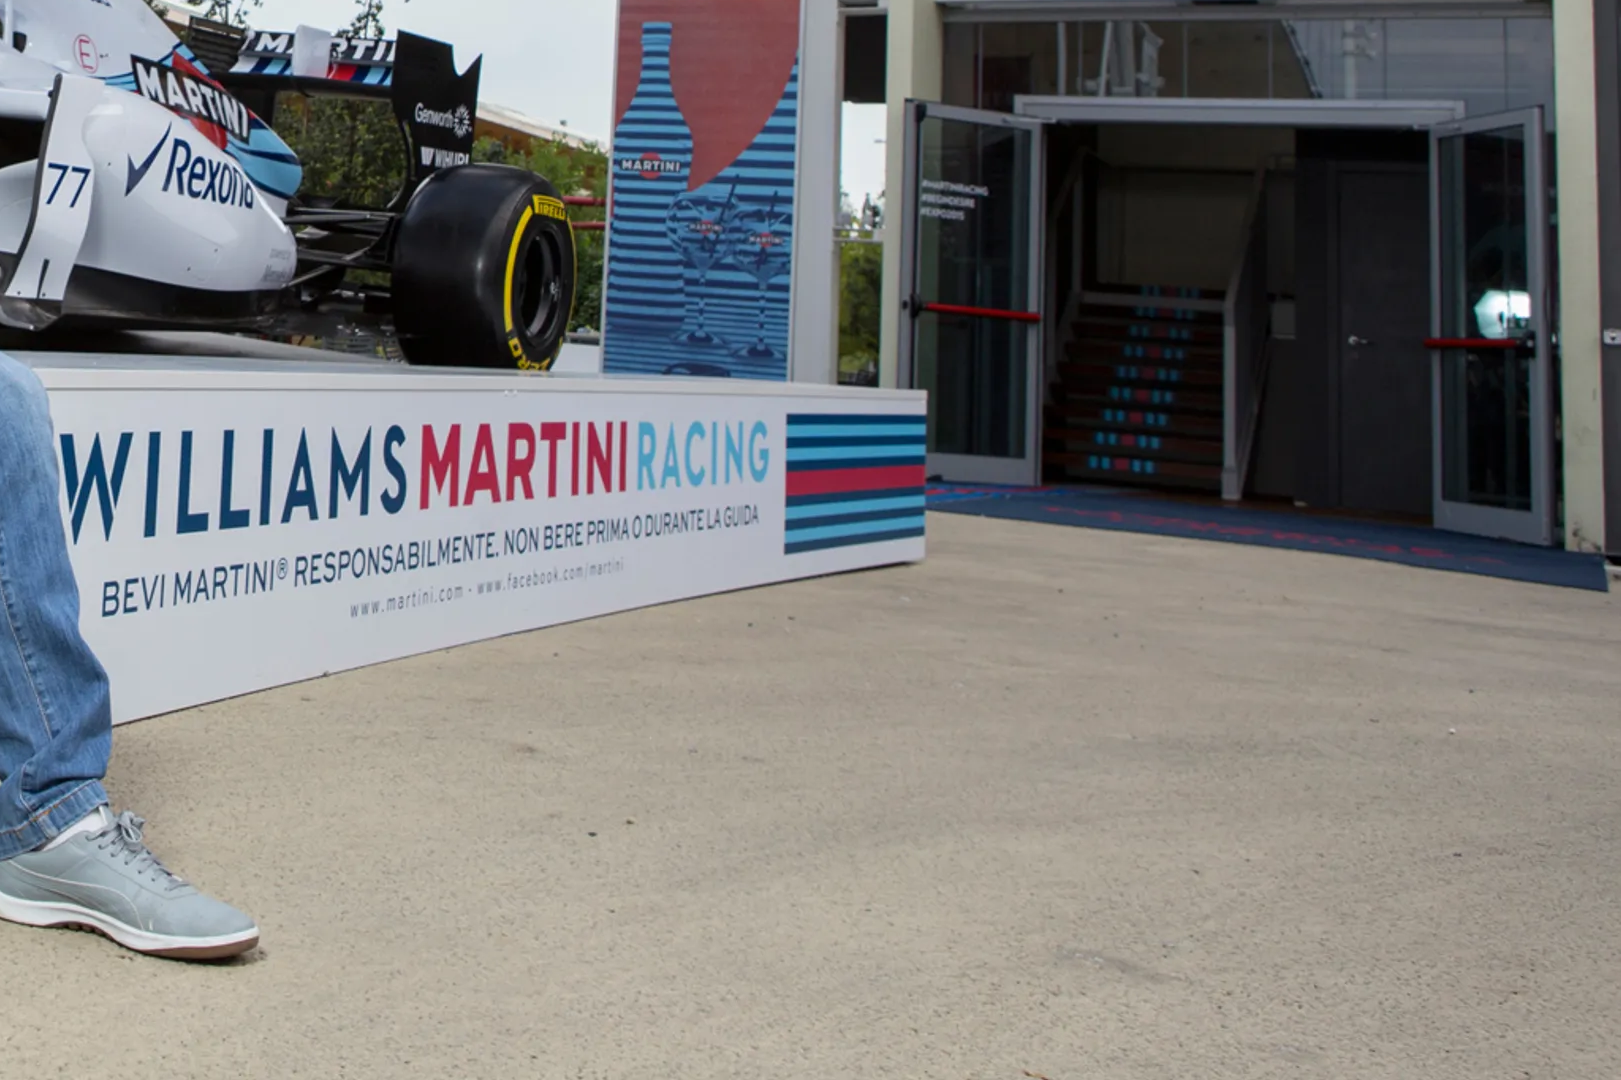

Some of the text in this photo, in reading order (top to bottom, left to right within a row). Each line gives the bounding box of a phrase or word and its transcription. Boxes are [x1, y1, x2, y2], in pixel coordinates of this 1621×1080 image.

[78, 38, 94, 70] E
[135, 62, 250, 138] MARTINI
[45, 162, 92, 208] 77
[162, 137, 255, 209] Rexona
[621, 159, 681, 172] MARTINI
[60, 420, 770, 546] WILLIAMS MARTINI RACING
[101, 573, 166, 618] BEVI
[293, 531, 499, 588] RESPONSABILMENTE.
[503, 526, 539, 557] NON
[543, 521, 584, 552] BERE
[586, 516, 630, 546] PRIMA
[631, 514, 642, 539] O
[644, 508, 704, 539] DURANTE
[706, 506, 722, 530] LA
[723, 503, 760, 529] GUIDA
[350, 584, 464, 618] www.martini.com
[477, 556, 625, 595] www.facebook.com/martini
